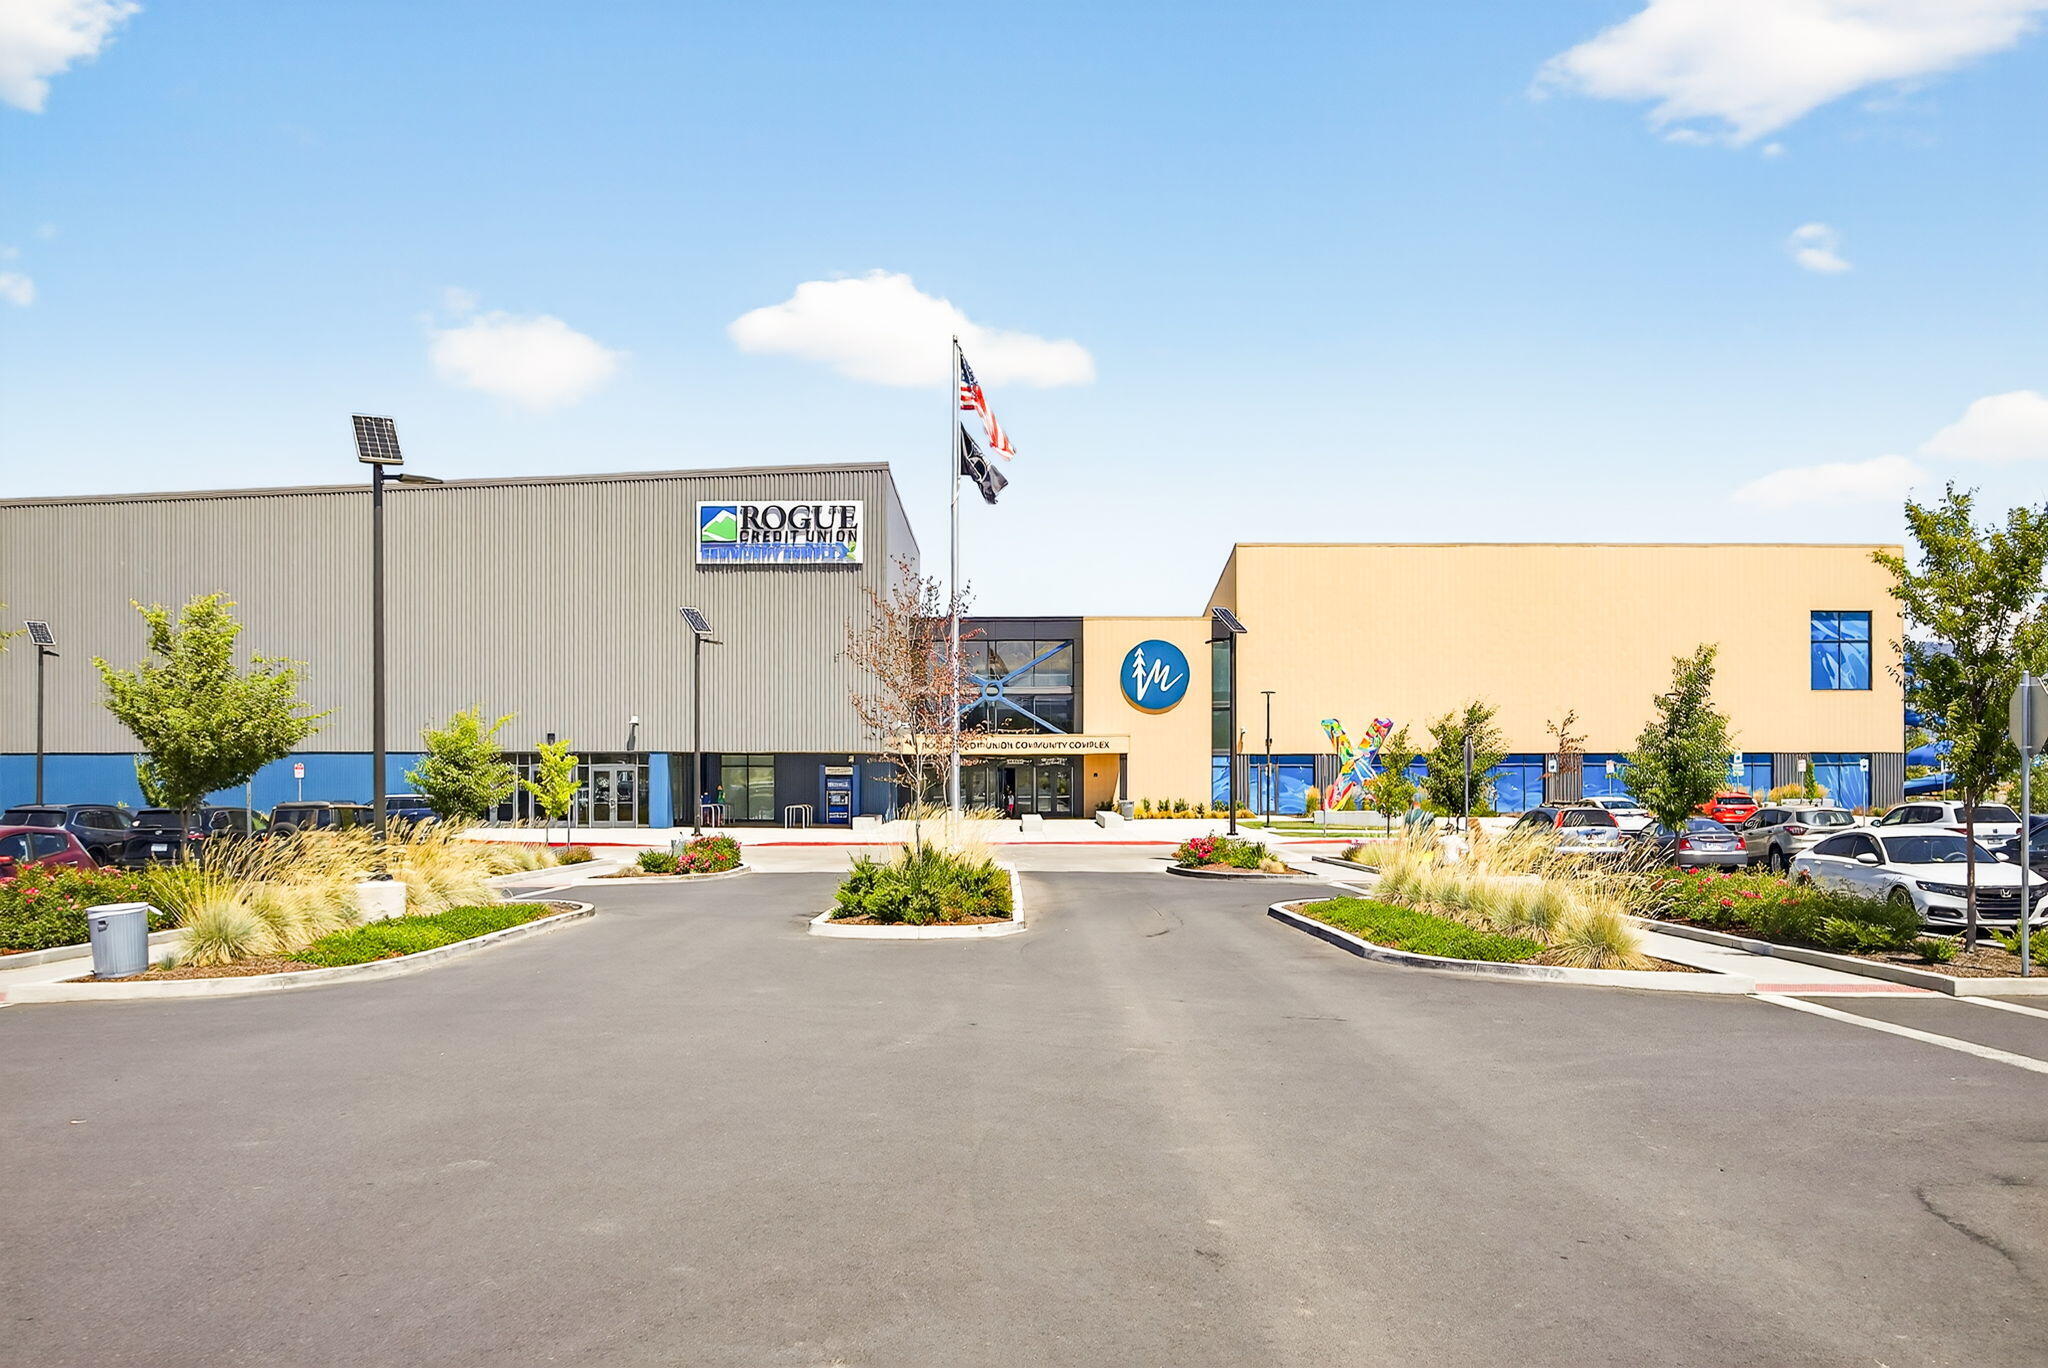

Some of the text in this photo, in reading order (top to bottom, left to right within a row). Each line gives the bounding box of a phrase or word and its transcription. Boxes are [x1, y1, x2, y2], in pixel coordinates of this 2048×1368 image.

[740, 505, 858, 530] ROGUE
[739, 530, 857, 544] CREDIT UNION
[986, 741, 1013, 750] UNION
[1015, 741, 1067, 749] COMMUNITY
[1068, 740, 1110, 749] COMPLEX
